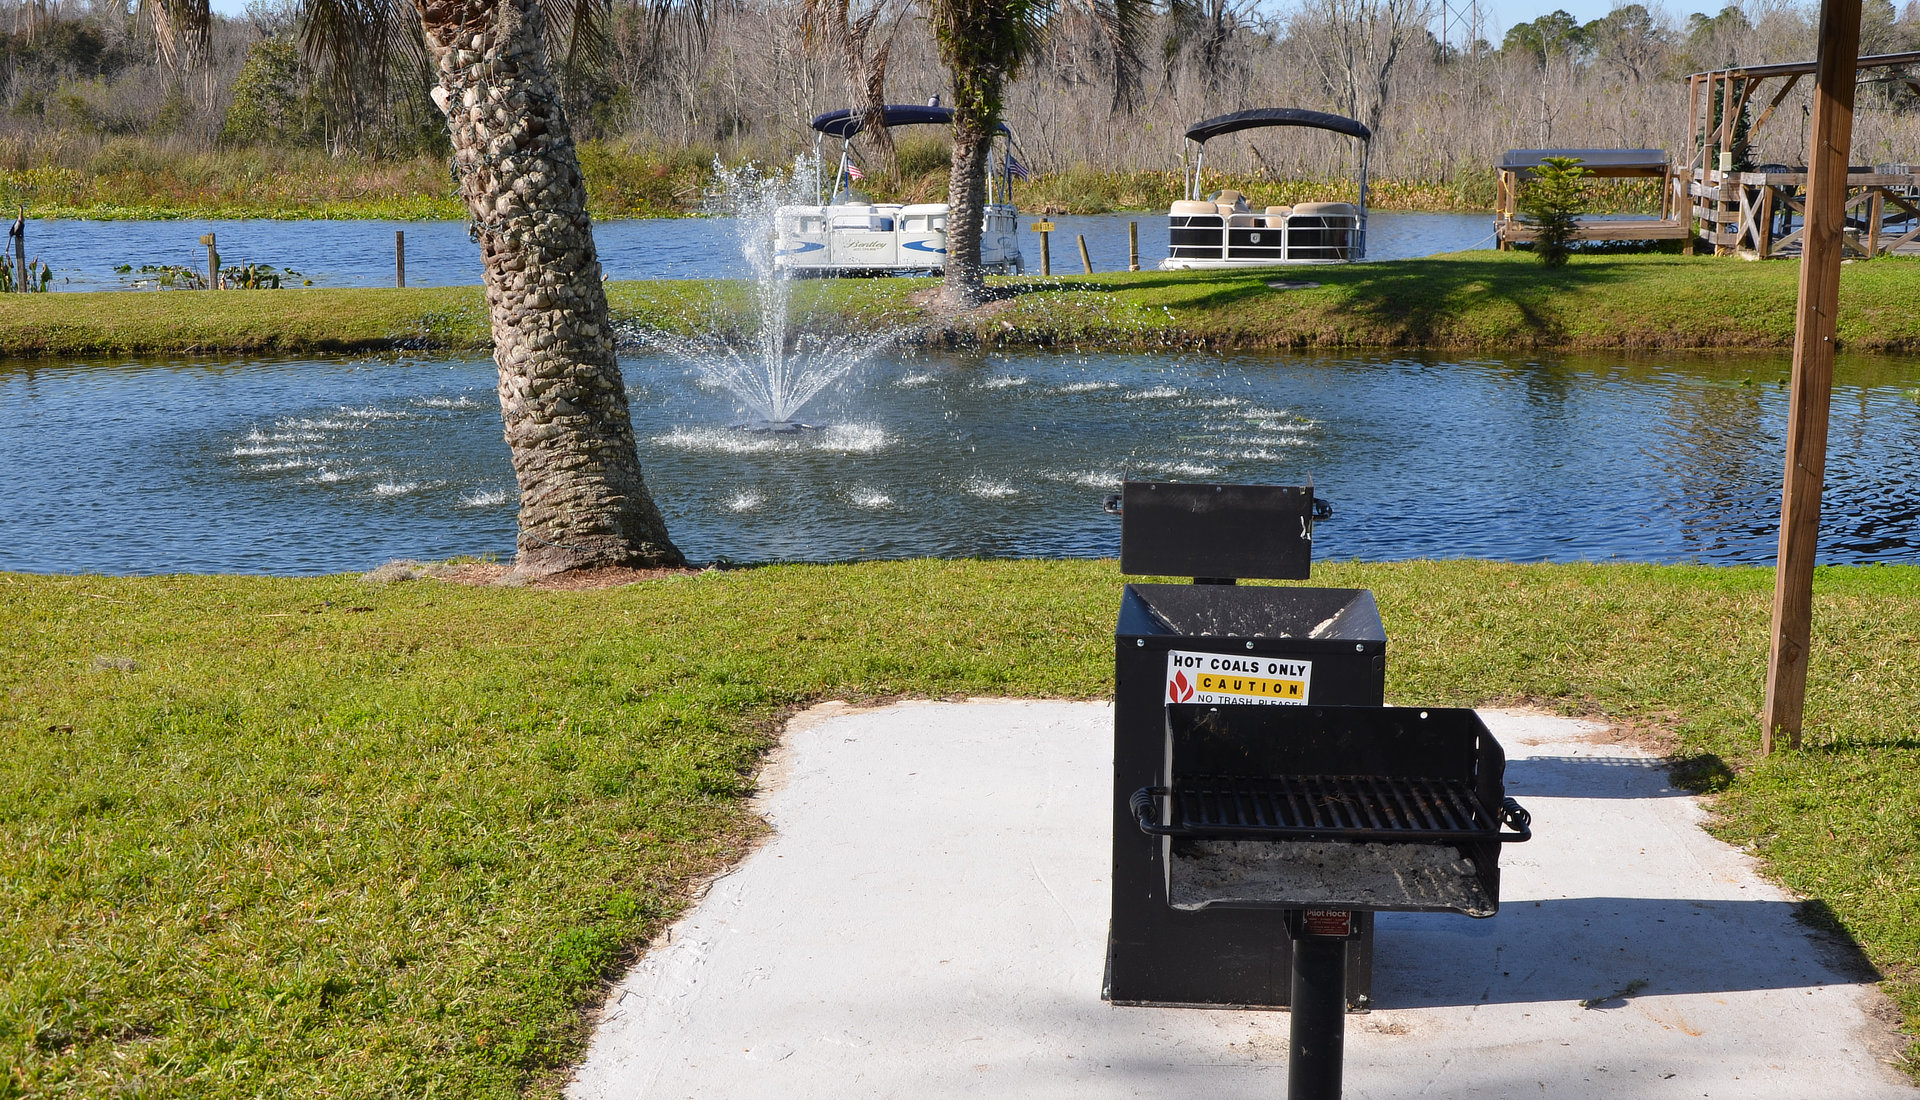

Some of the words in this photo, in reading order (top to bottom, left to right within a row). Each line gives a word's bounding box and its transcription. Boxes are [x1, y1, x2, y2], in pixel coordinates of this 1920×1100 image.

[845, 239, 887, 249] Bentley
[1173, 655, 1203, 669] HOT
[1210, 658, 1260, 673] COALS
[1267, 663, 1306, 677] ONLY
[1203, 677, 1298, 695] CAUTION
[1197, 694, 1213, 704] NO
[1218, 695, 1253, 705] TRASH
